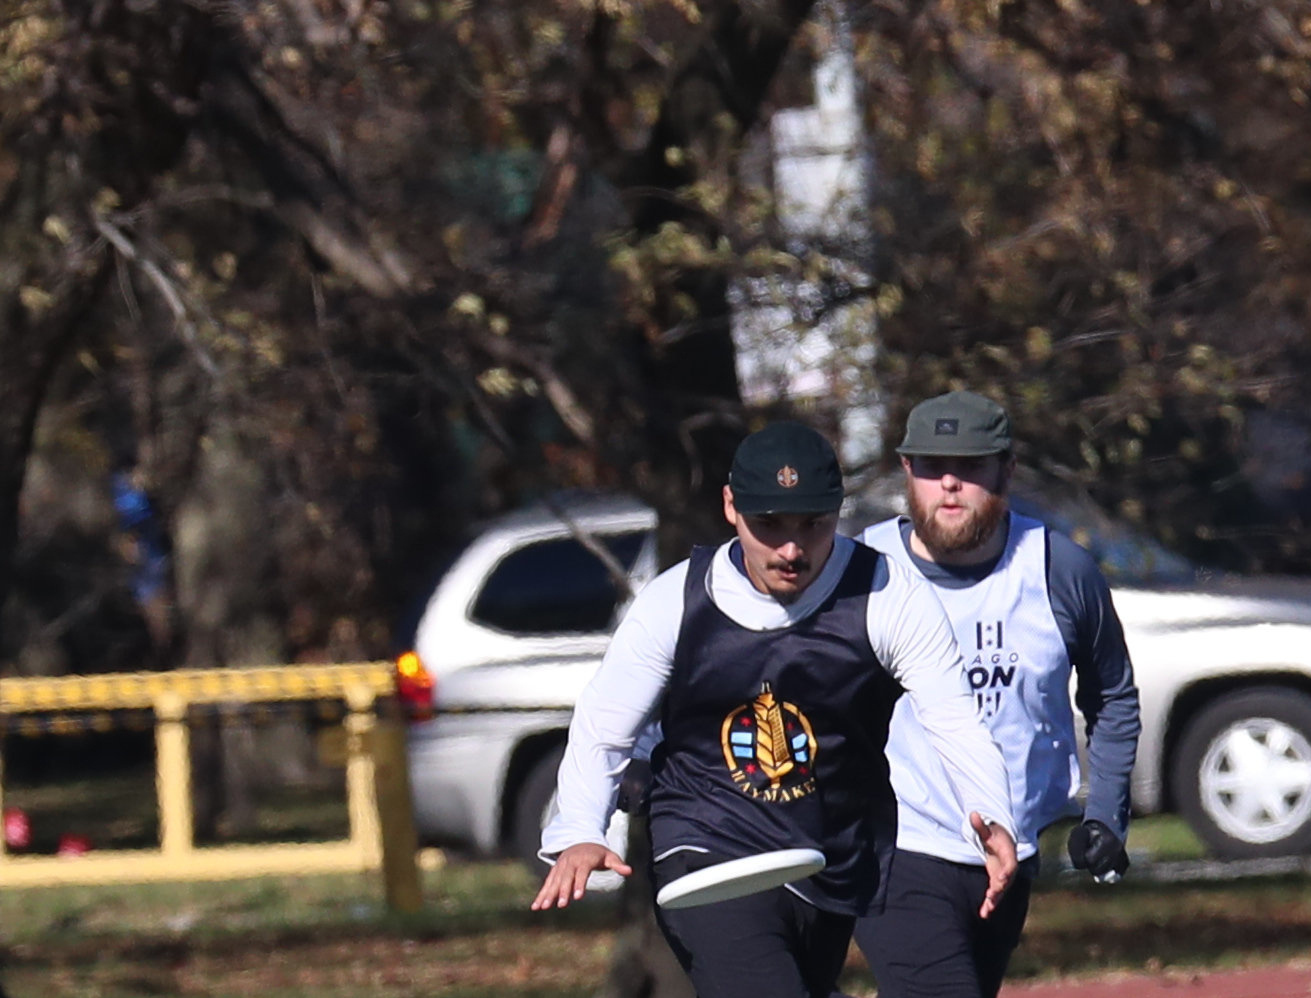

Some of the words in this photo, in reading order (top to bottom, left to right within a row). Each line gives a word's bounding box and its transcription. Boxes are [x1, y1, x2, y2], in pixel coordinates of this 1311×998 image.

[971, 652, 1019, 665] AGO
[968, 666, 1016, 690] ON
[731, 769, 816, 802] HAYMAKE
